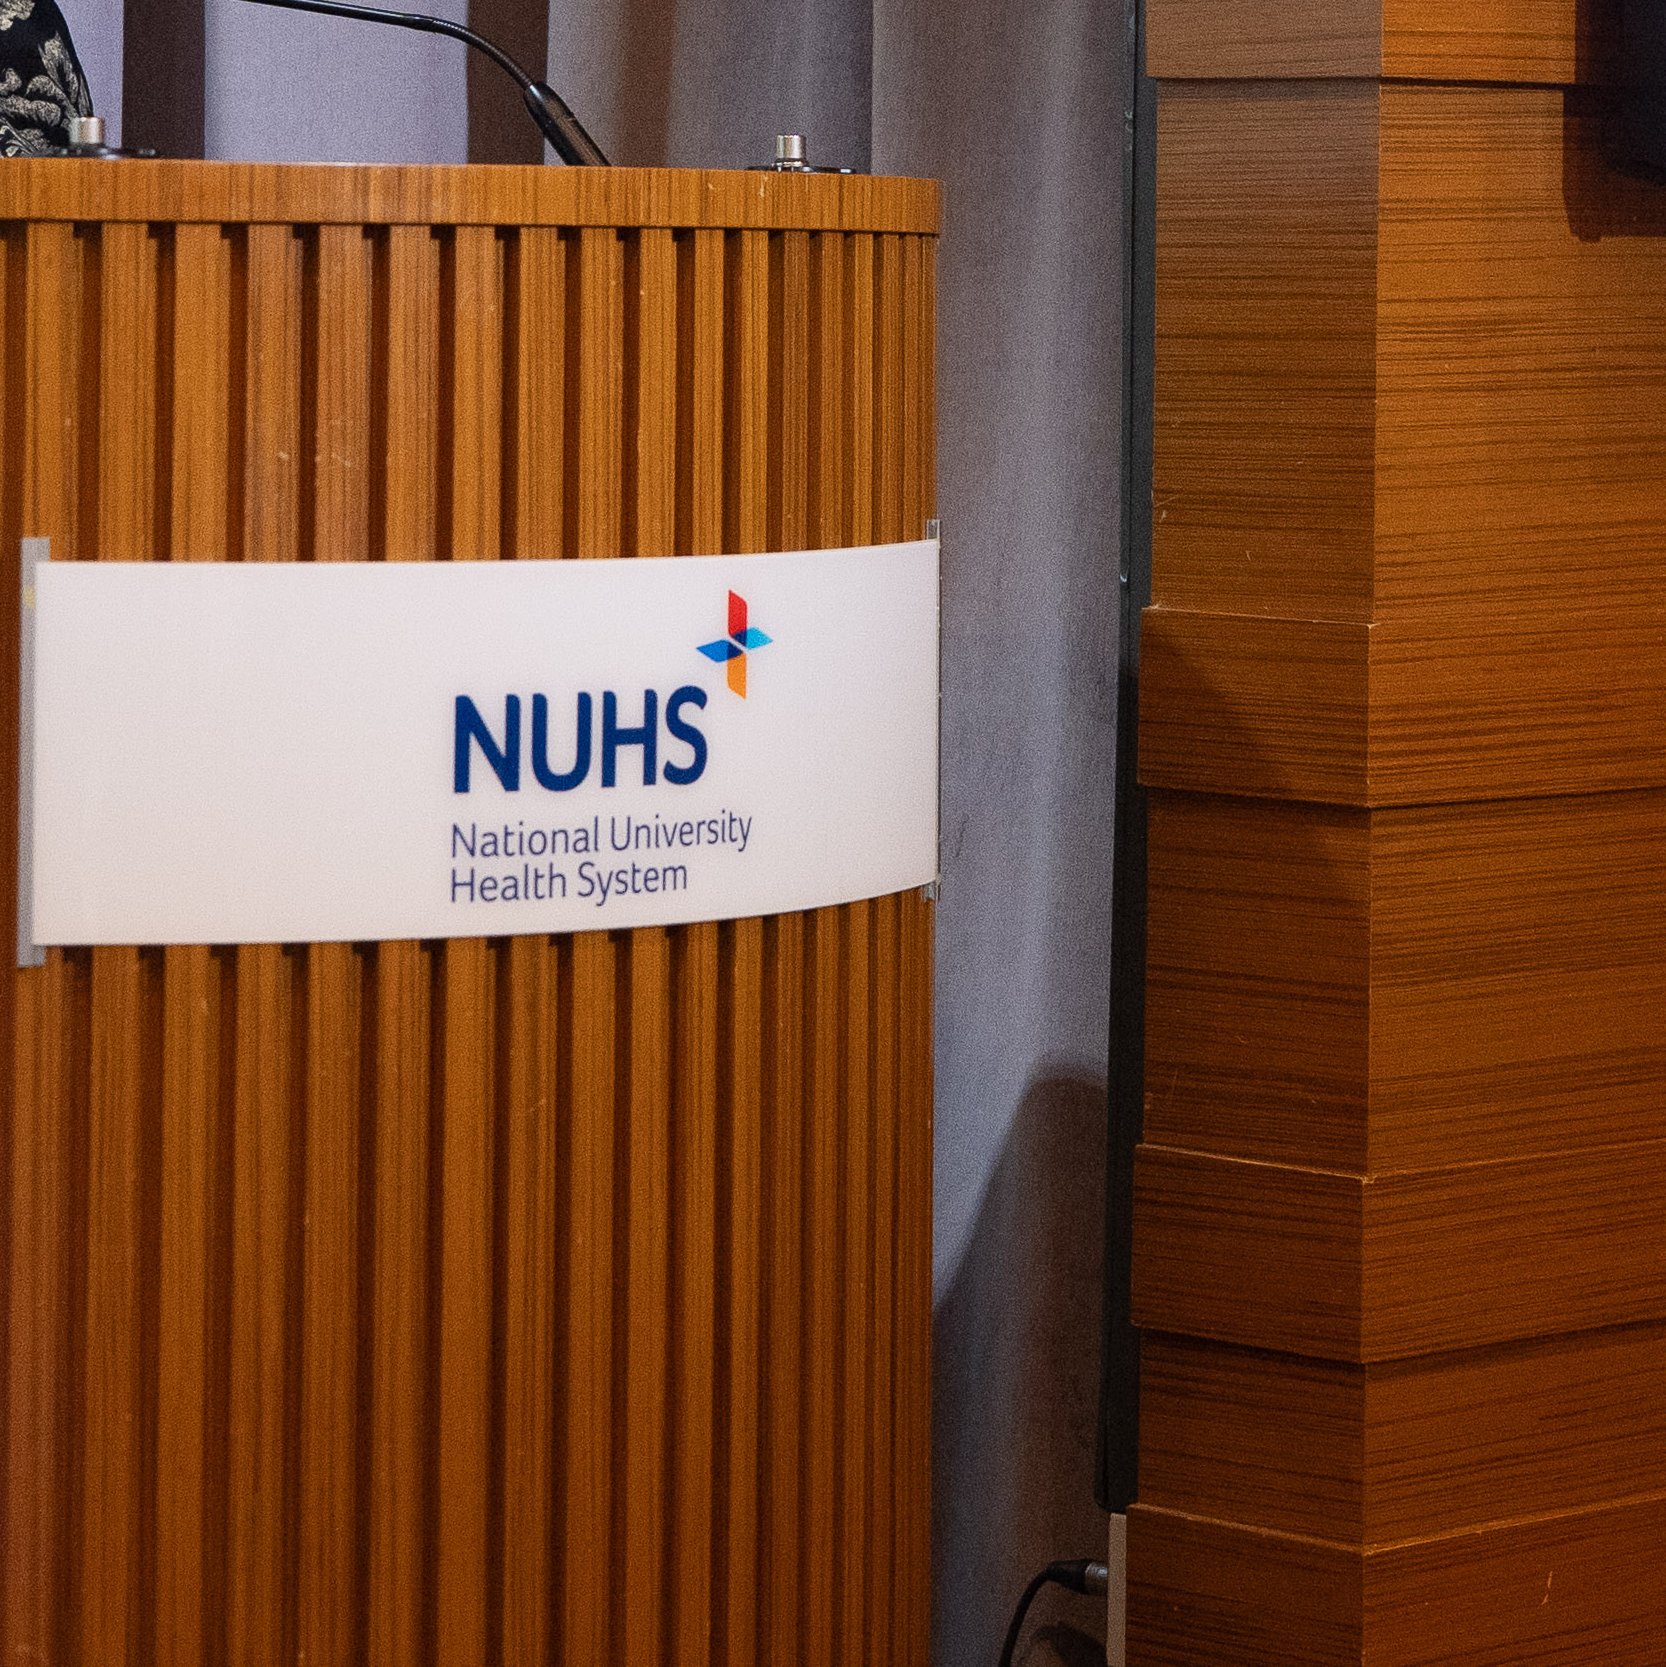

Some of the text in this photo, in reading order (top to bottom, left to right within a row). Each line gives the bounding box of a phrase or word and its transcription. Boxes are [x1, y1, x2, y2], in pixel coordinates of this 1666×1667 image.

[454, 685, 708, 793] NUHS
[451, 809, 752, 859] National University
[451, 861, 688, 907] Health System
